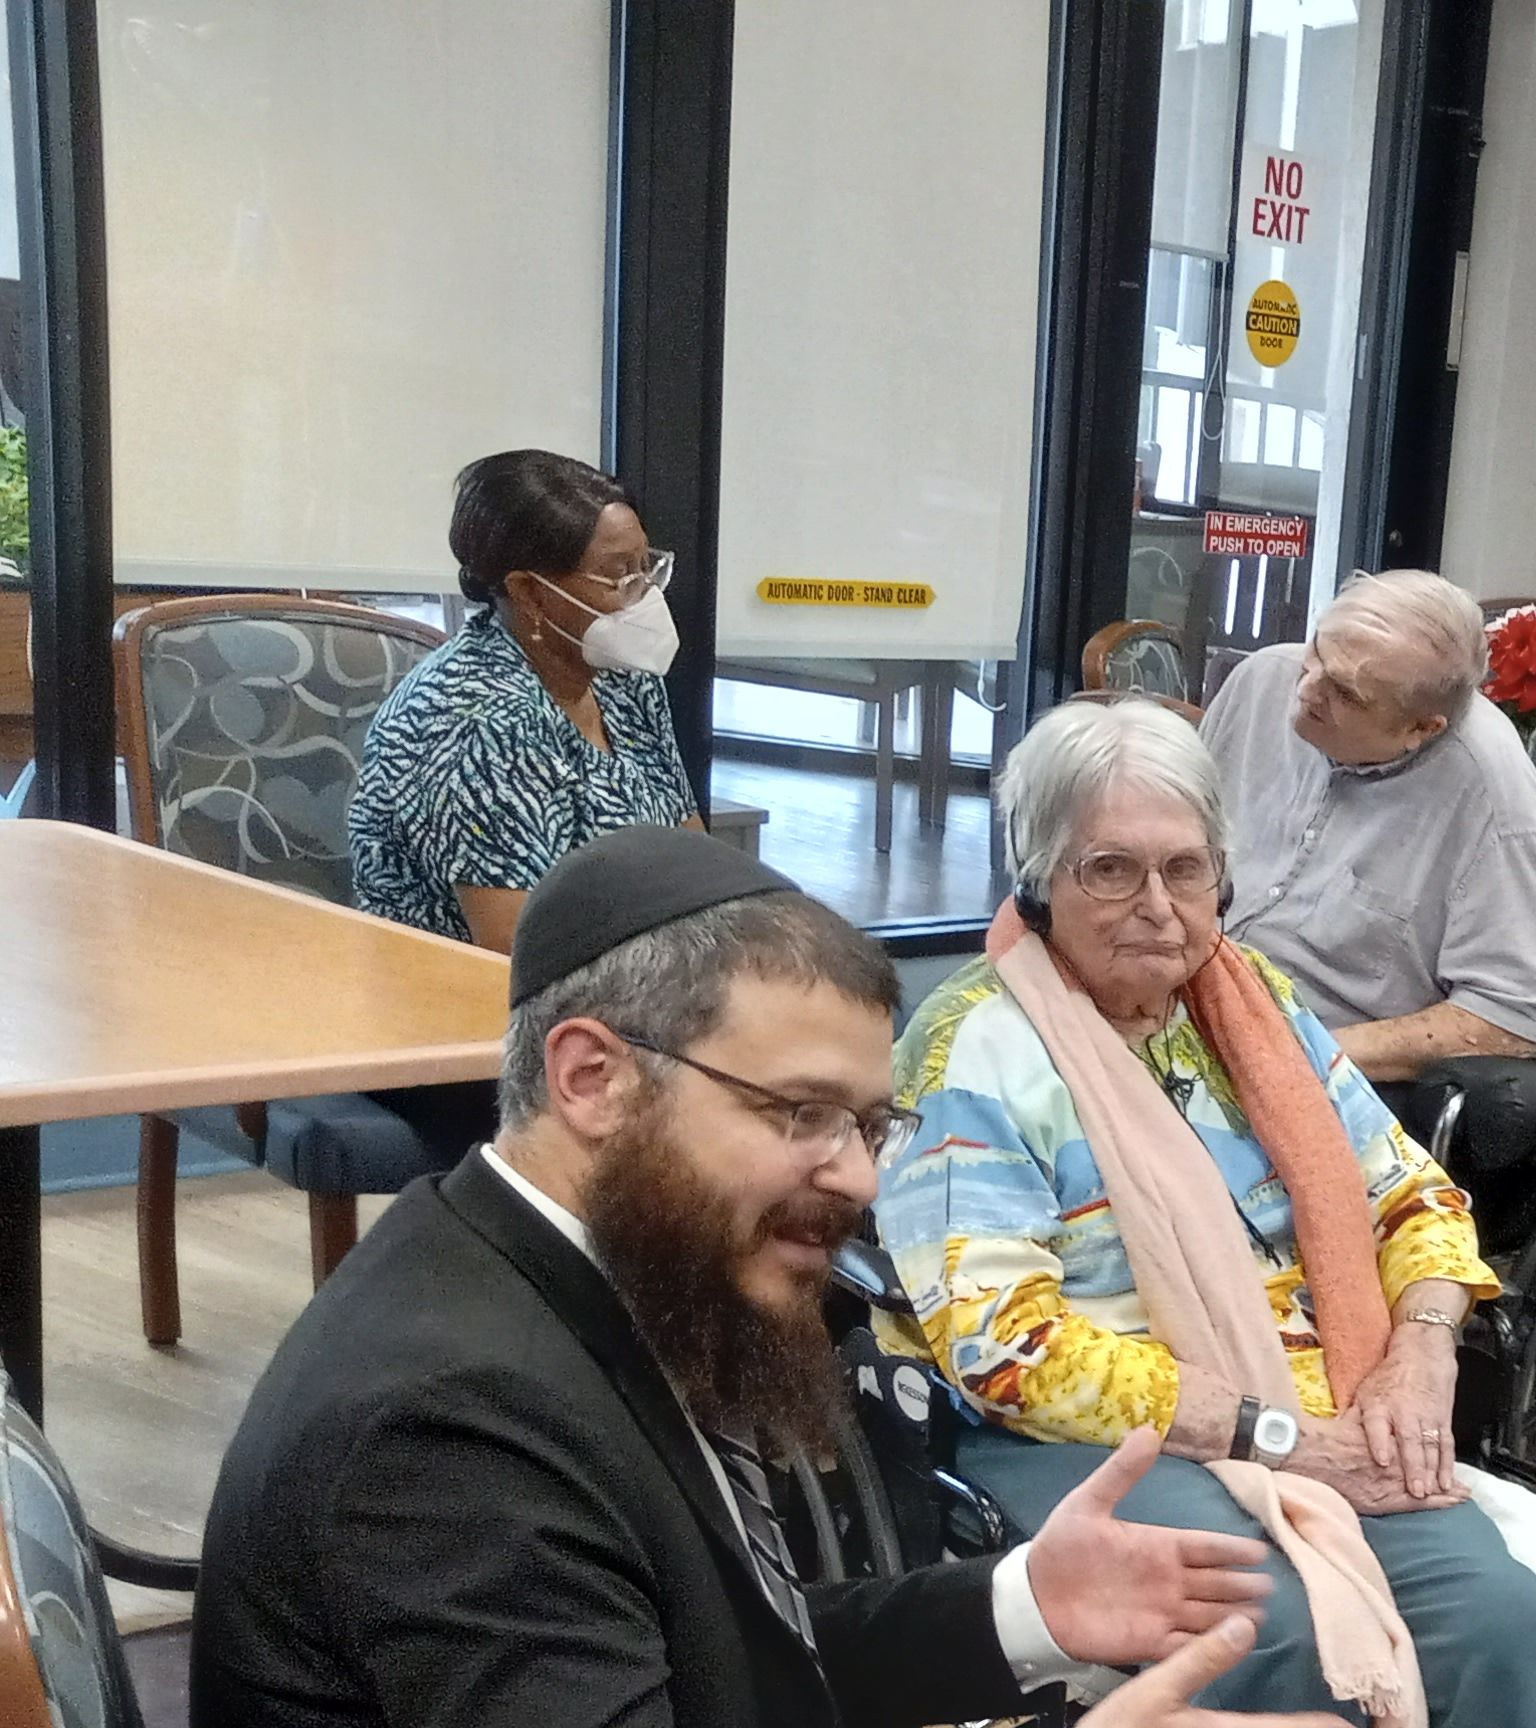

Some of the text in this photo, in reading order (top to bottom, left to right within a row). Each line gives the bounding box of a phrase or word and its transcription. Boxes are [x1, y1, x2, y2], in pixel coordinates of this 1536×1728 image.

[1264, 156, 1303, 200] NO
[1252, 197, 1310, 245] EXIT
[1249, 314, 1298, 335] CAUTION
[1210, 514, 1303, 536] IN EMERGENCY
[1209, 536, 1300, 557] PUSH TO OPEN
[767, 583, 824, 599] AUTOMATIC
[828, 585, 855, 602] DOOR
[863, 586, 893, 603] STAND
[897, 587, 926, 604] CLEAR
